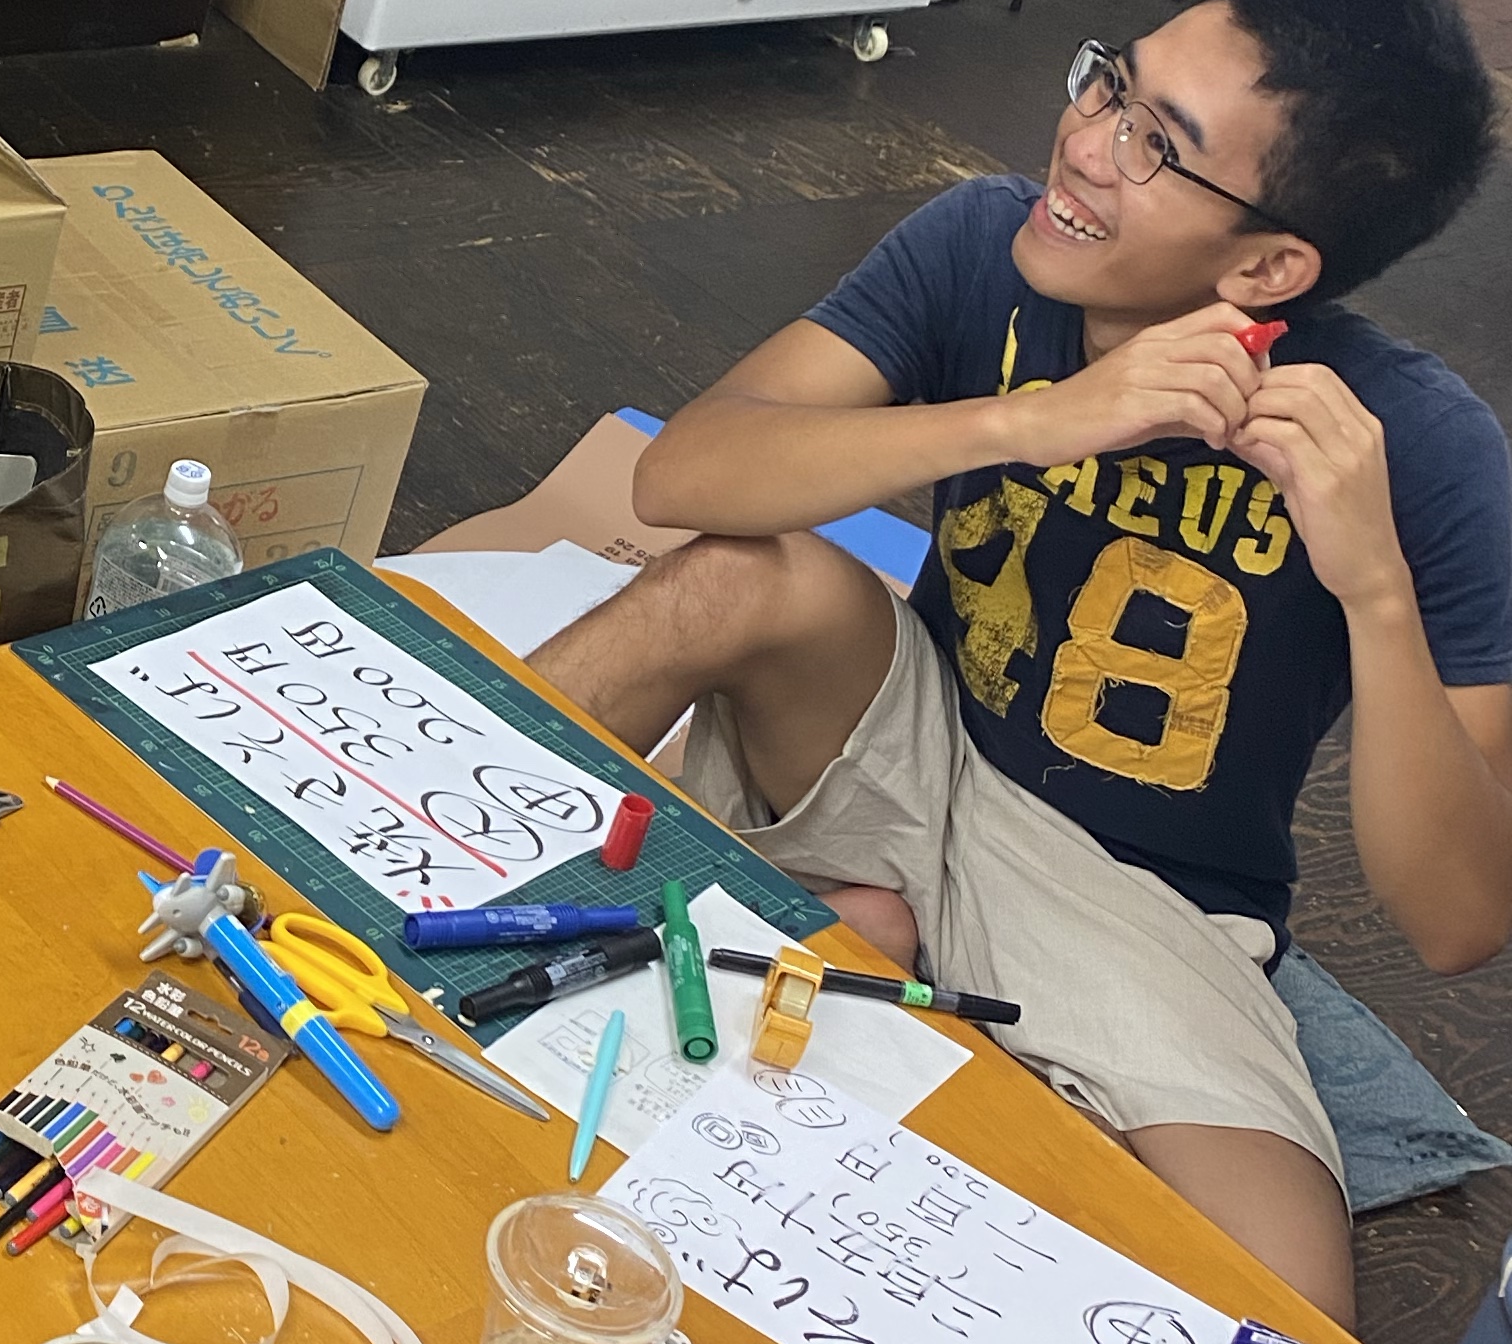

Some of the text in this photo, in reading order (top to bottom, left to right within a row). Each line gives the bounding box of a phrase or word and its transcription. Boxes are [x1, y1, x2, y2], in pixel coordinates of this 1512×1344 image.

[222, 640, 414, 768] 350円
[280, 618, 486, 745] 200円
[129, 664, 477, 887] 焼きそば
[141, 989, 185, 1019] 色鉛筆
[156, 981, 187, 1003] 水彩
[208, 1046, 253, 1078] PENCILS
[713, 1159, 1001, 1338] 三百五十円
[835, 1145, 1058, 1272] 二百円
